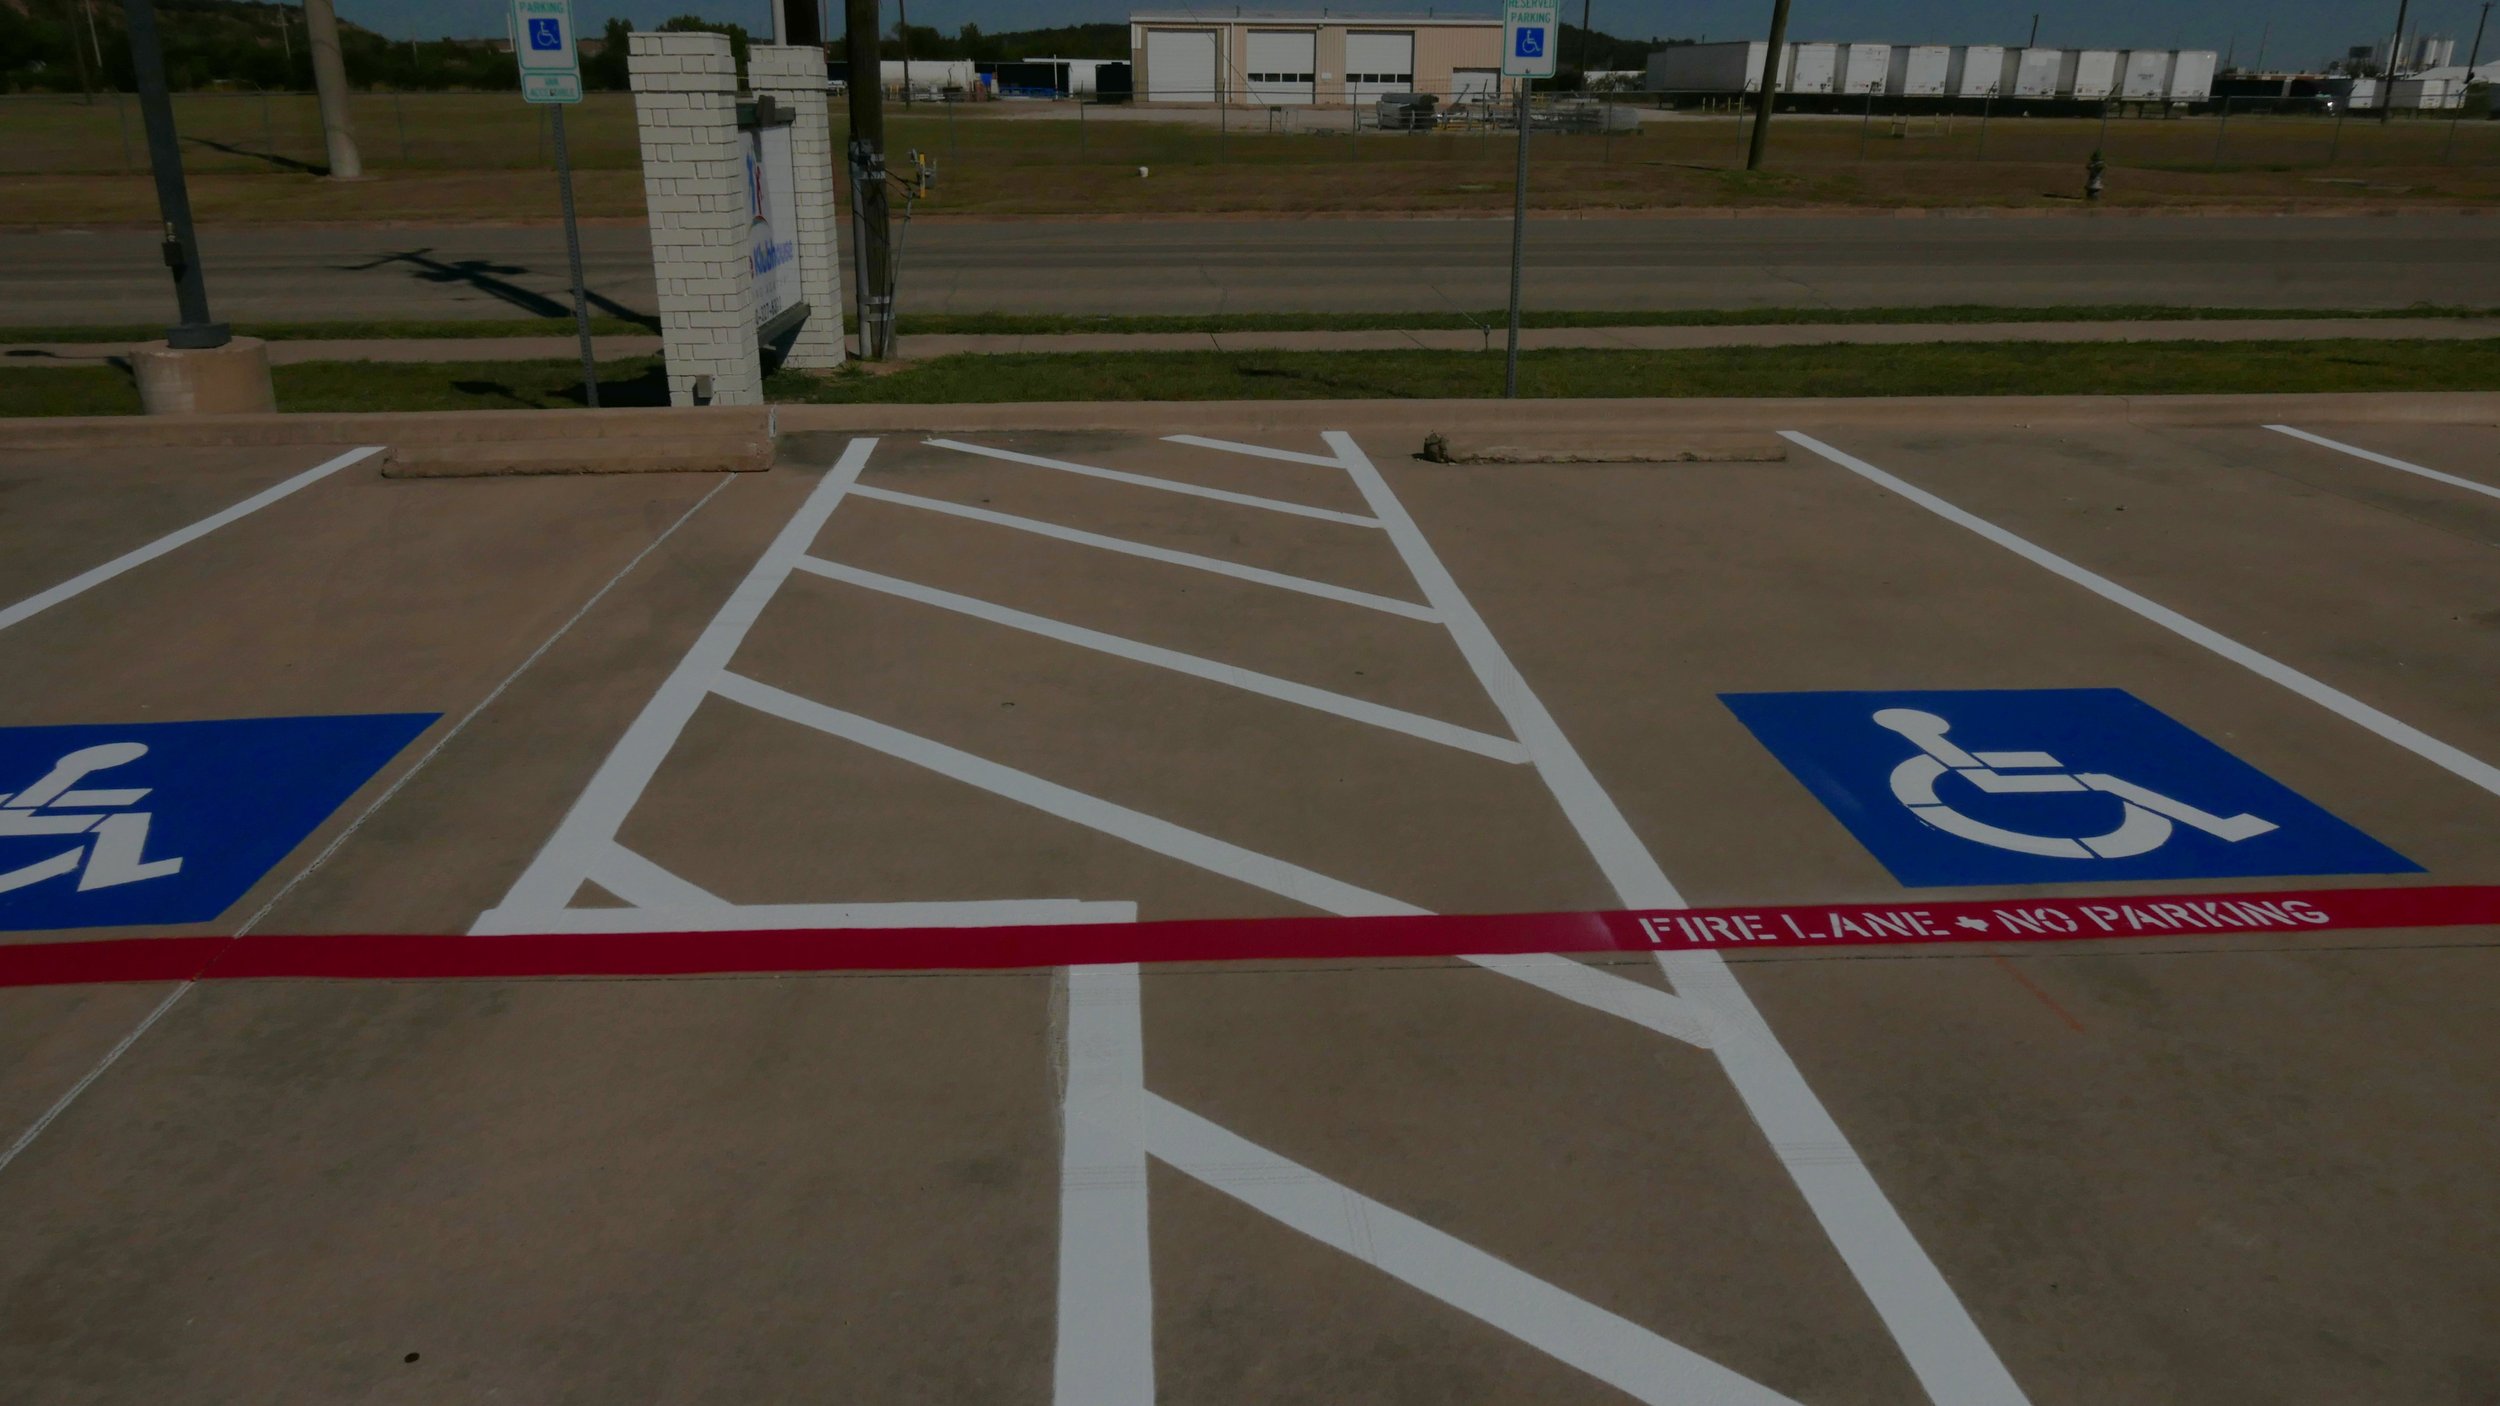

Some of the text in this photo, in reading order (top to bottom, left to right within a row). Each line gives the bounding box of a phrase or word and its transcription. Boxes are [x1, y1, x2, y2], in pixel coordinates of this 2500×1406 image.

[519, 2, 563, 13] PARKING
[1508, 0, 1554, 8] RESERVED
[1511, 12, 1551, 23] PARKING
[1637, 900, 2331, 944] FIRE LANE NO PARKING
